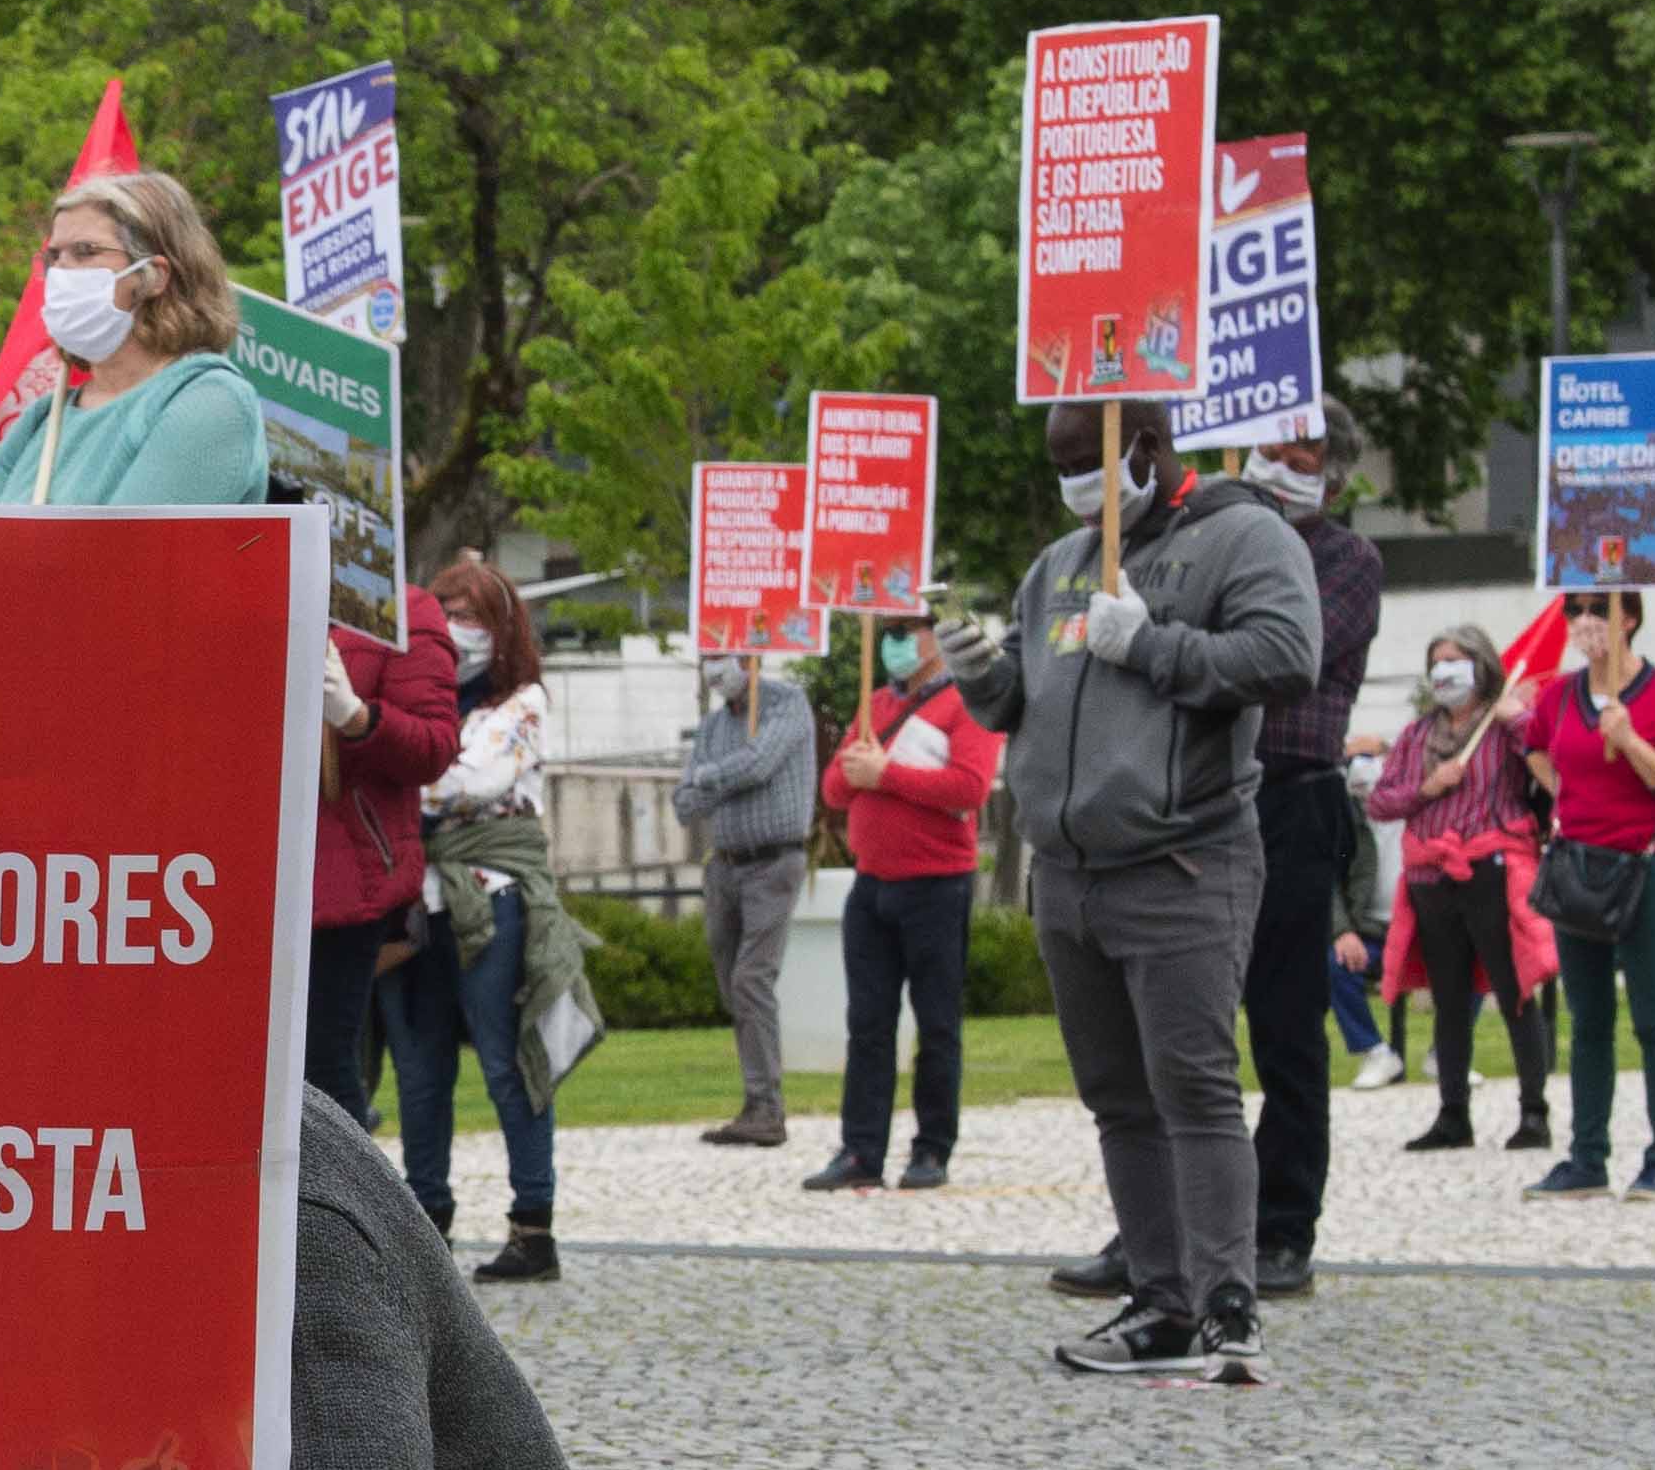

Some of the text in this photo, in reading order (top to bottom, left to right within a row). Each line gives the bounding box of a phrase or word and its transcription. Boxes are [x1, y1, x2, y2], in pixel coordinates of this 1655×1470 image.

[1042, 32, 1191, 82] A CONSTITUIÇÃO
[1041, 76, 1170, 121] DA REPÚBLICA
[282, 86, 368, 177] STAL
[1039, 118, 1157, 161] PORTUGUESA
[288, 133, 395, 238] EXIGE
[1037, 156, 1165, 198] E OS DIREITOS
[1037, 197, 1124, 236] SÃO PARA
[306, 261, 326, 288] DE
[1035, 236, 1123, 275] CUMPRIR!
[236, 332, 383, 418] NOVARES
[1209, 345, 1256, 386] OM
[1171, 375, 1300, 438] IREITOS
[1558, 380, 1624, 403] MOTEL
[1558, 406, 1630, 429] CARIBE
